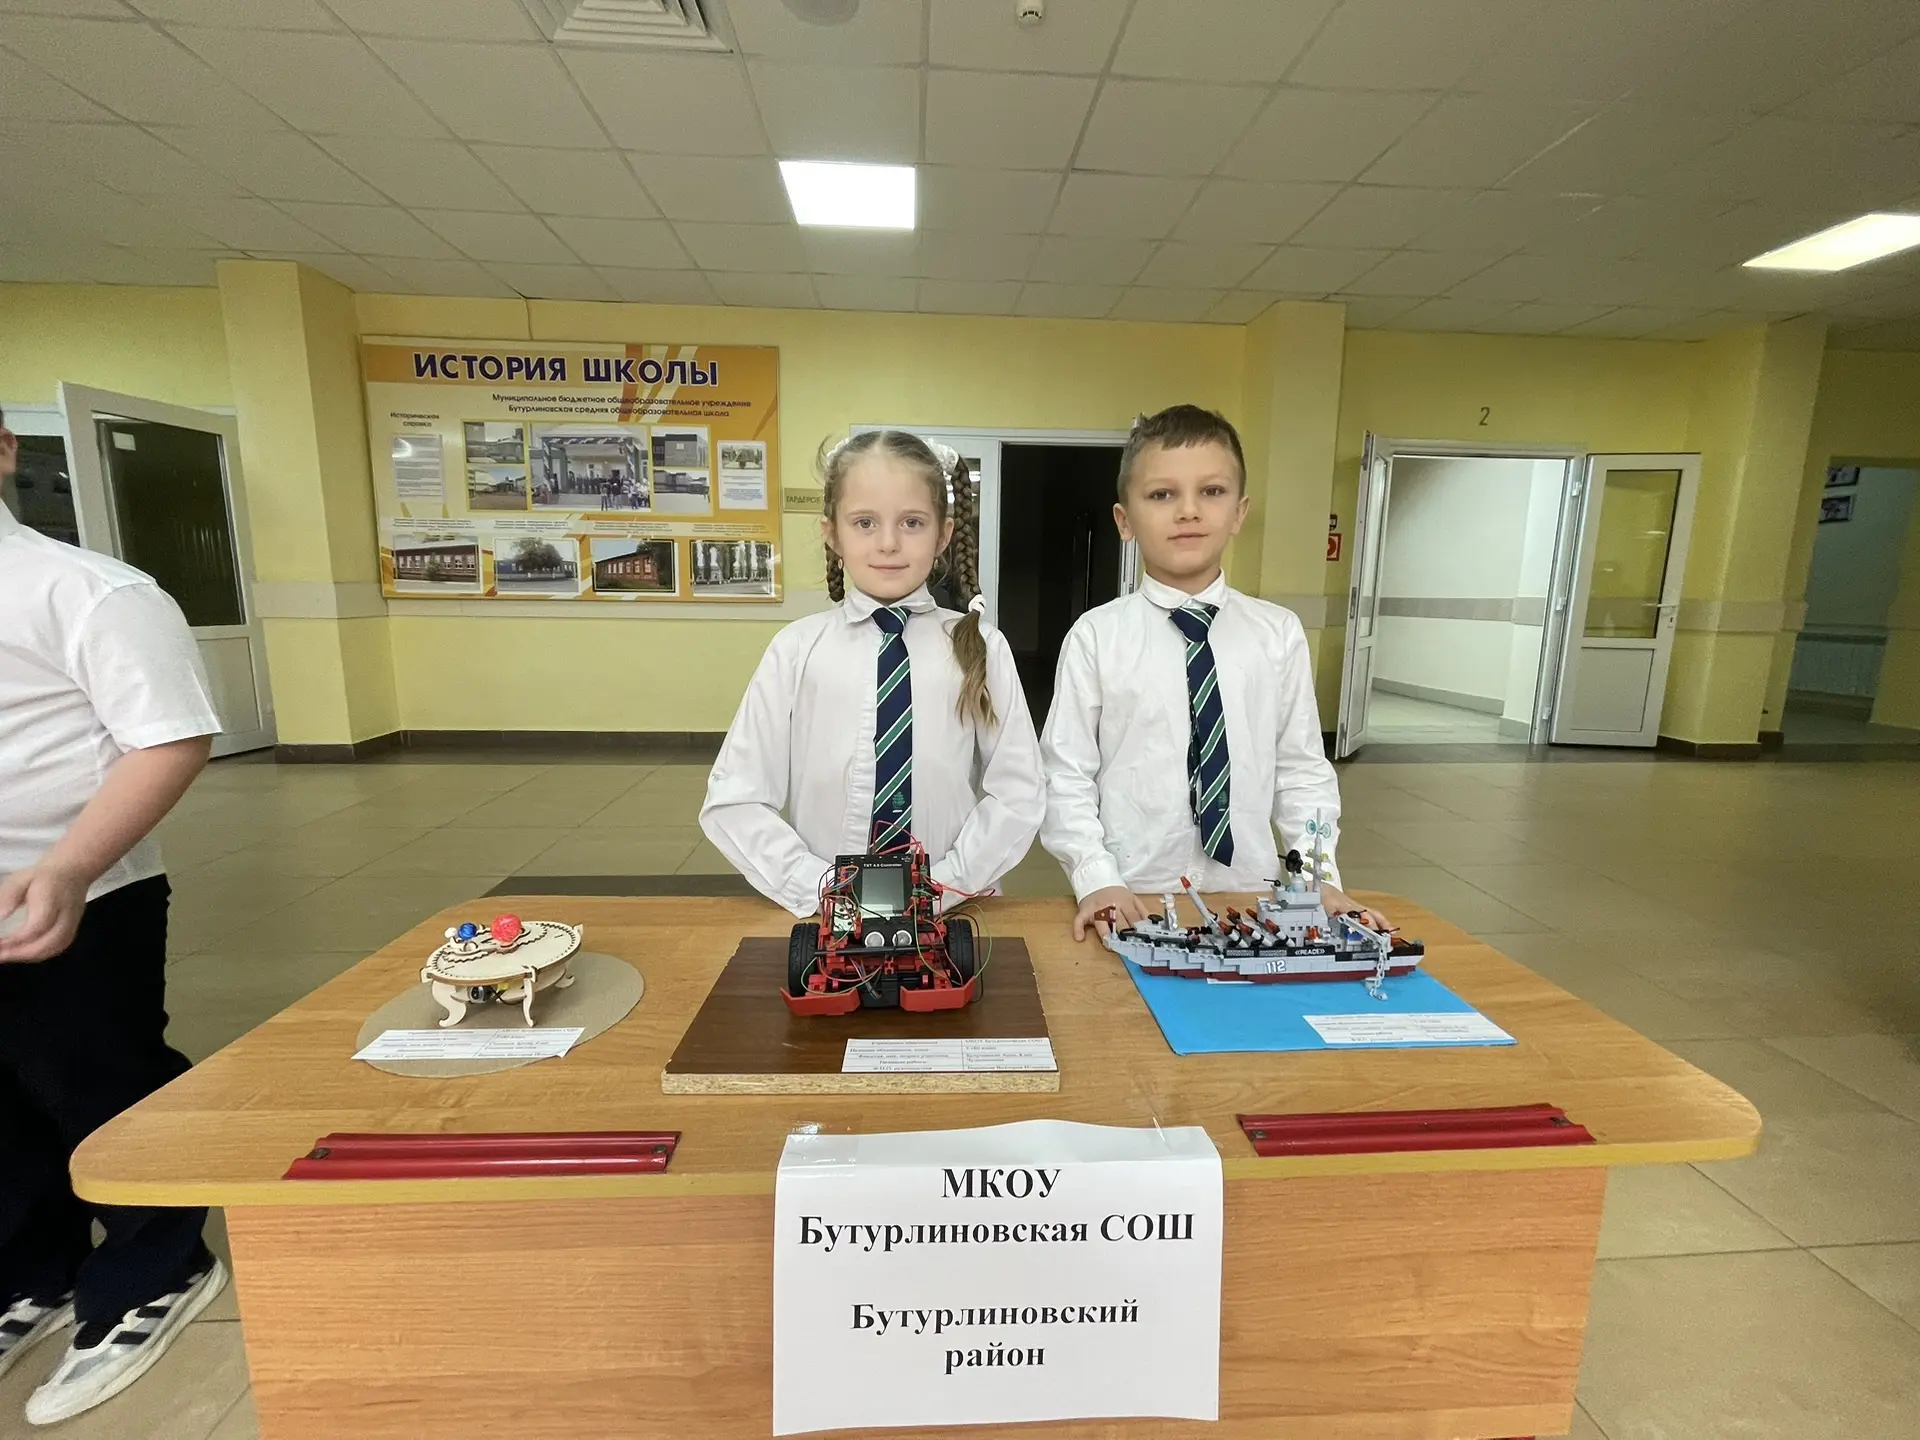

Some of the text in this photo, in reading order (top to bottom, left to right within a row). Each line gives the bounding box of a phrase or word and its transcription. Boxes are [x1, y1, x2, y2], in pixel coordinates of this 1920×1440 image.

[413, 353, 718, 386] ИСТОРИЯ ШКОЛЫ
[492, 393, 752, 408] Муниципальное бюджетное общеобразовательное учреждение
[508, 404, 574, 413] Бутурлиновская
[574, 406, 609, 414] средняя
[610, 406, 702, 417] общеобразовательная
[1479, 406, 1490, 426] 2
[1266, 959, 1287, 975] 112
[941, 1167, 1062, 1200] МКОУ
[798, 1212, 1195, 1253] Бутурлиновская СОШ
[850, 1298, 1140, 1336] Бутурлиновский
[943, 1341, 1046, 1376] район
